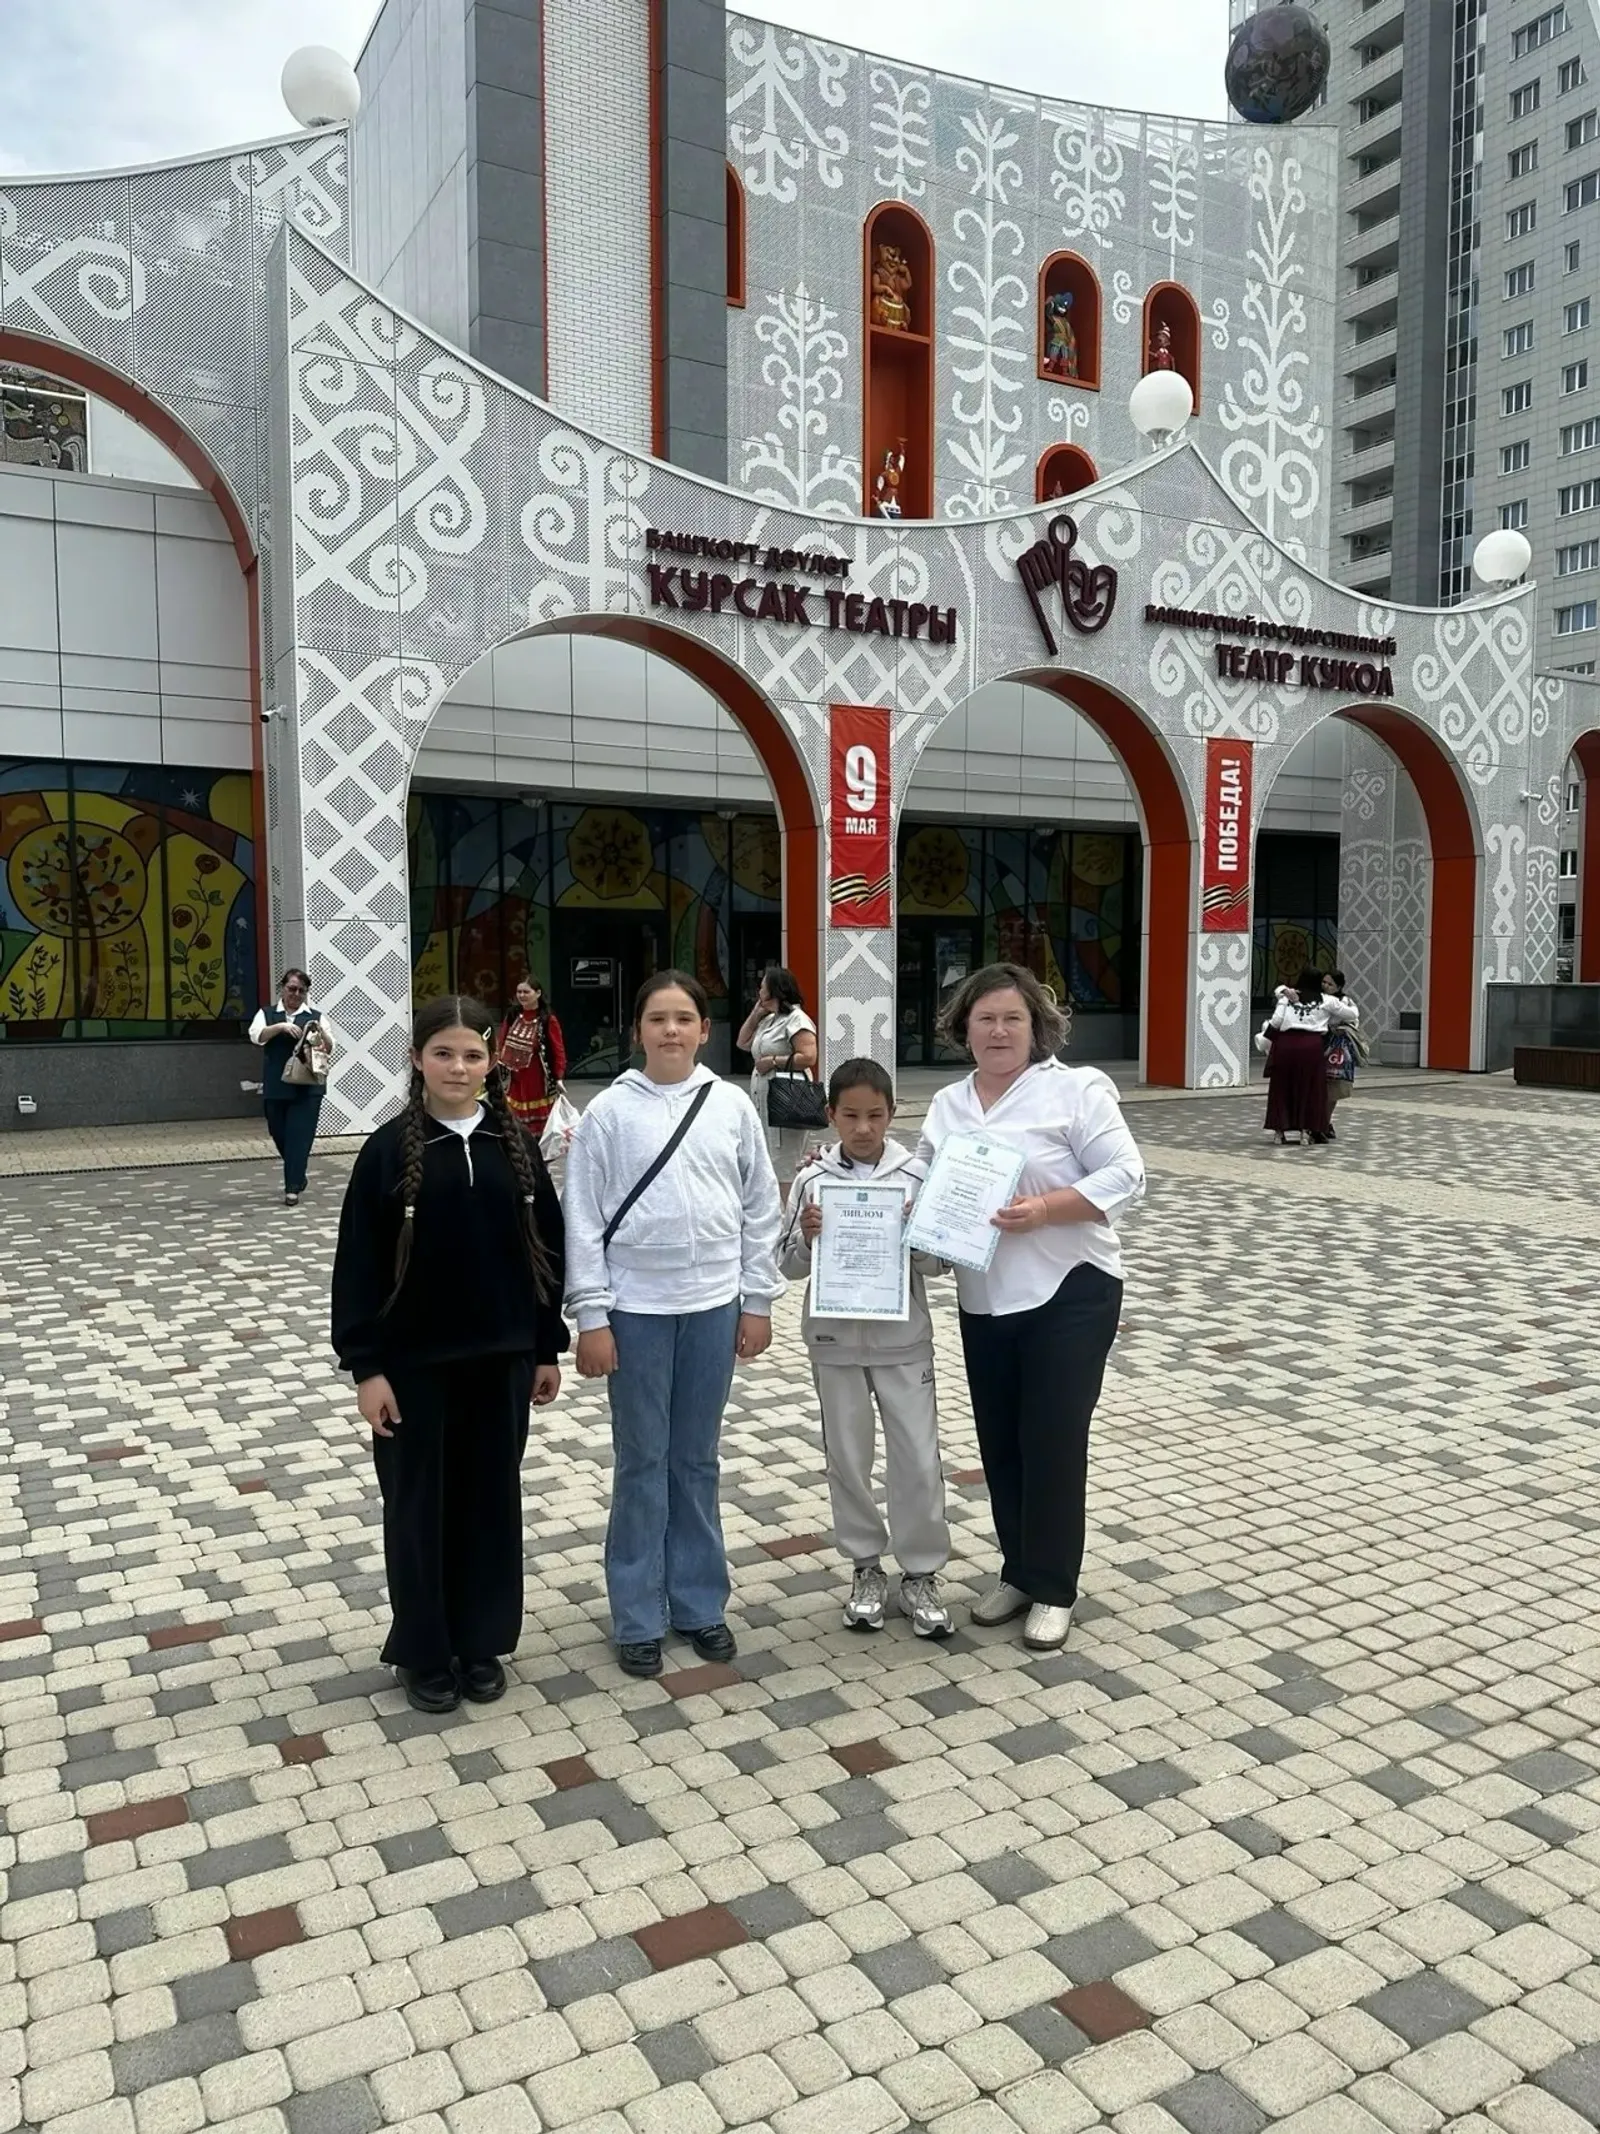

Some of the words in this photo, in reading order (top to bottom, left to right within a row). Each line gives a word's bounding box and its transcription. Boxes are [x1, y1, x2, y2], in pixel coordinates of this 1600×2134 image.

[824, 589, 957, 645] ТЕАТРЫ
[1145, 604, 1256, 637] БАШКИРСКИЙ
[1258, 621, 1397, 656] ГОСУДАРСТВЕННЫЙ
[1215, 643, 1295, 684] ТЕАТР
[1301, 655, 1394, 697] КУКОЛ
[845, 745, 877, 813] 9
[845, 817, 877, 835] МАЯ
[1218, 758, 1242, 872] ПОБЕДА!
[840, 1209, 884, 1219] ДИПЛОМ
